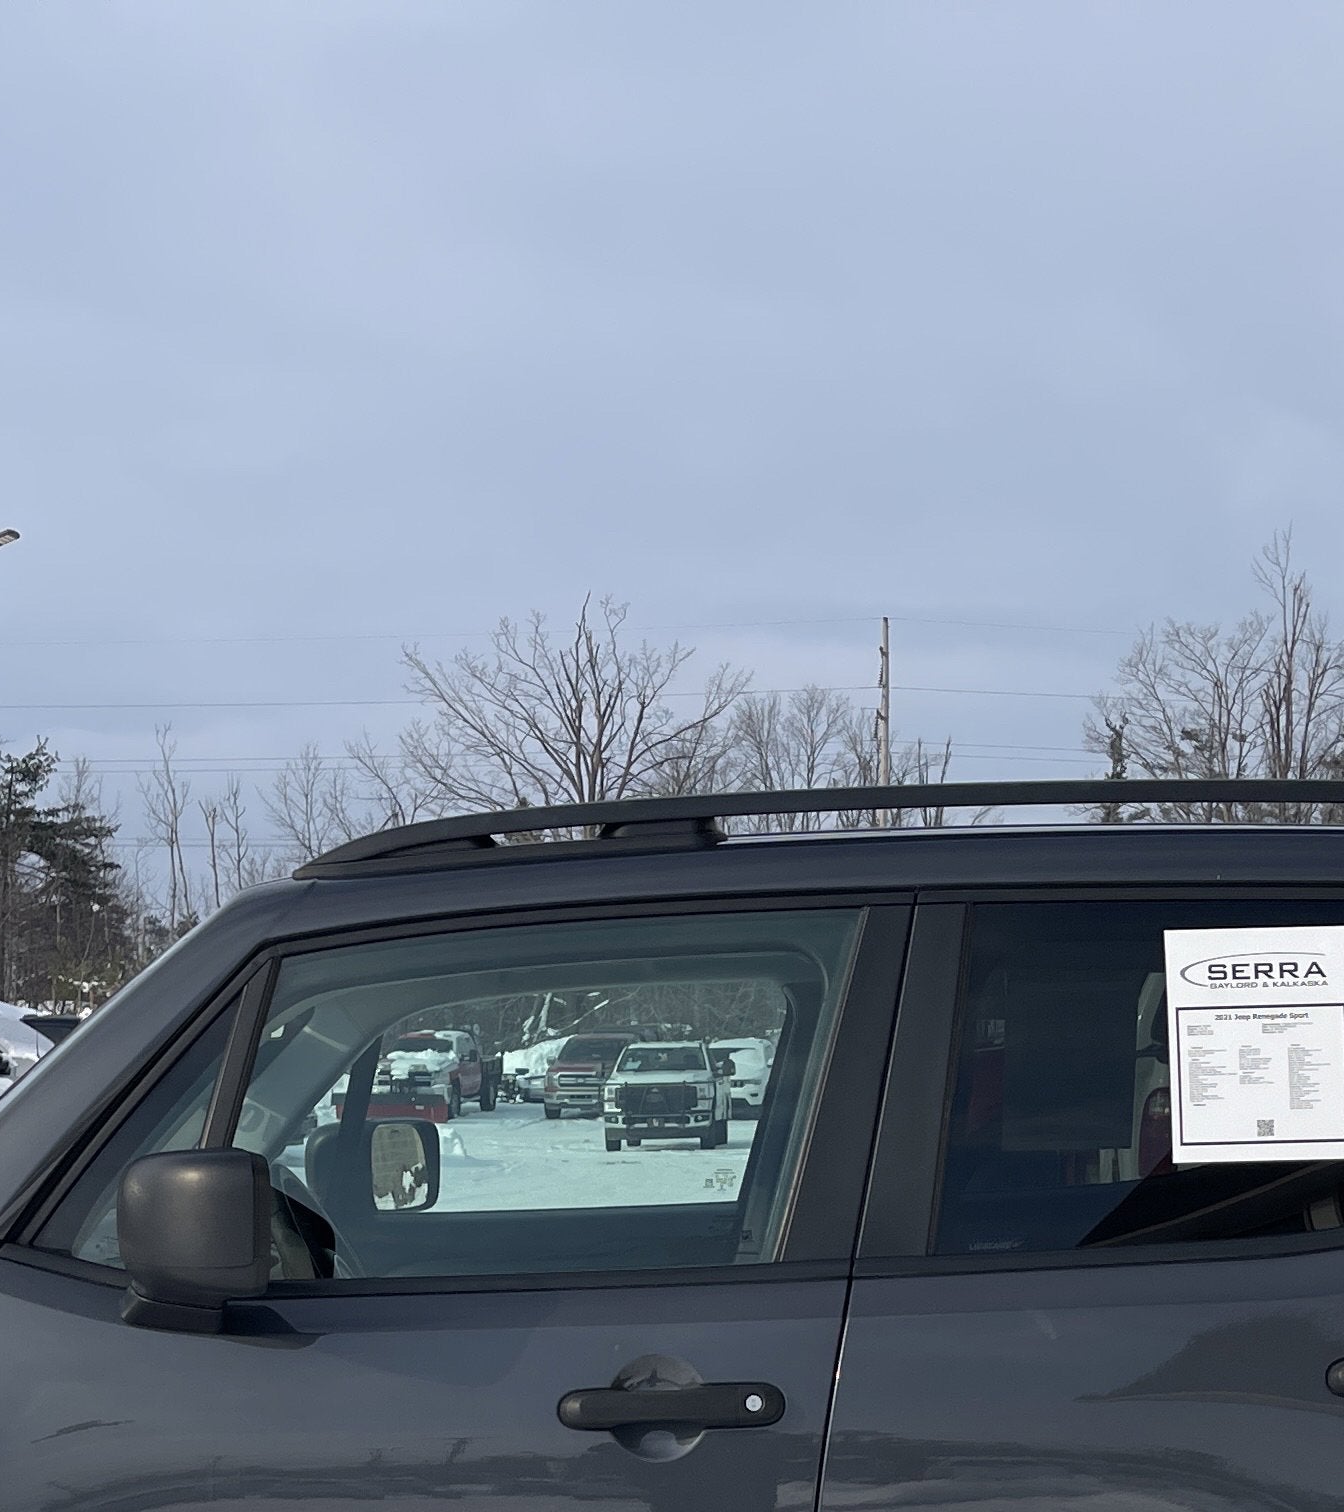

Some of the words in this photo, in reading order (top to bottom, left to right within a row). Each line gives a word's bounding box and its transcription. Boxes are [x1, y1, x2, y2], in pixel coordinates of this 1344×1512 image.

[1207, 961, 1327, 981] SERRA
[1209, 982, 1259, 990] GAYLORD
[1272, 980, 1329, 989] KALKASKA
[1234, 1013, 1251, 1022] Jeep
[1252, 1012, 1288, 1021] Renegade
[1289, 1011, 1309, 1021] Sport
